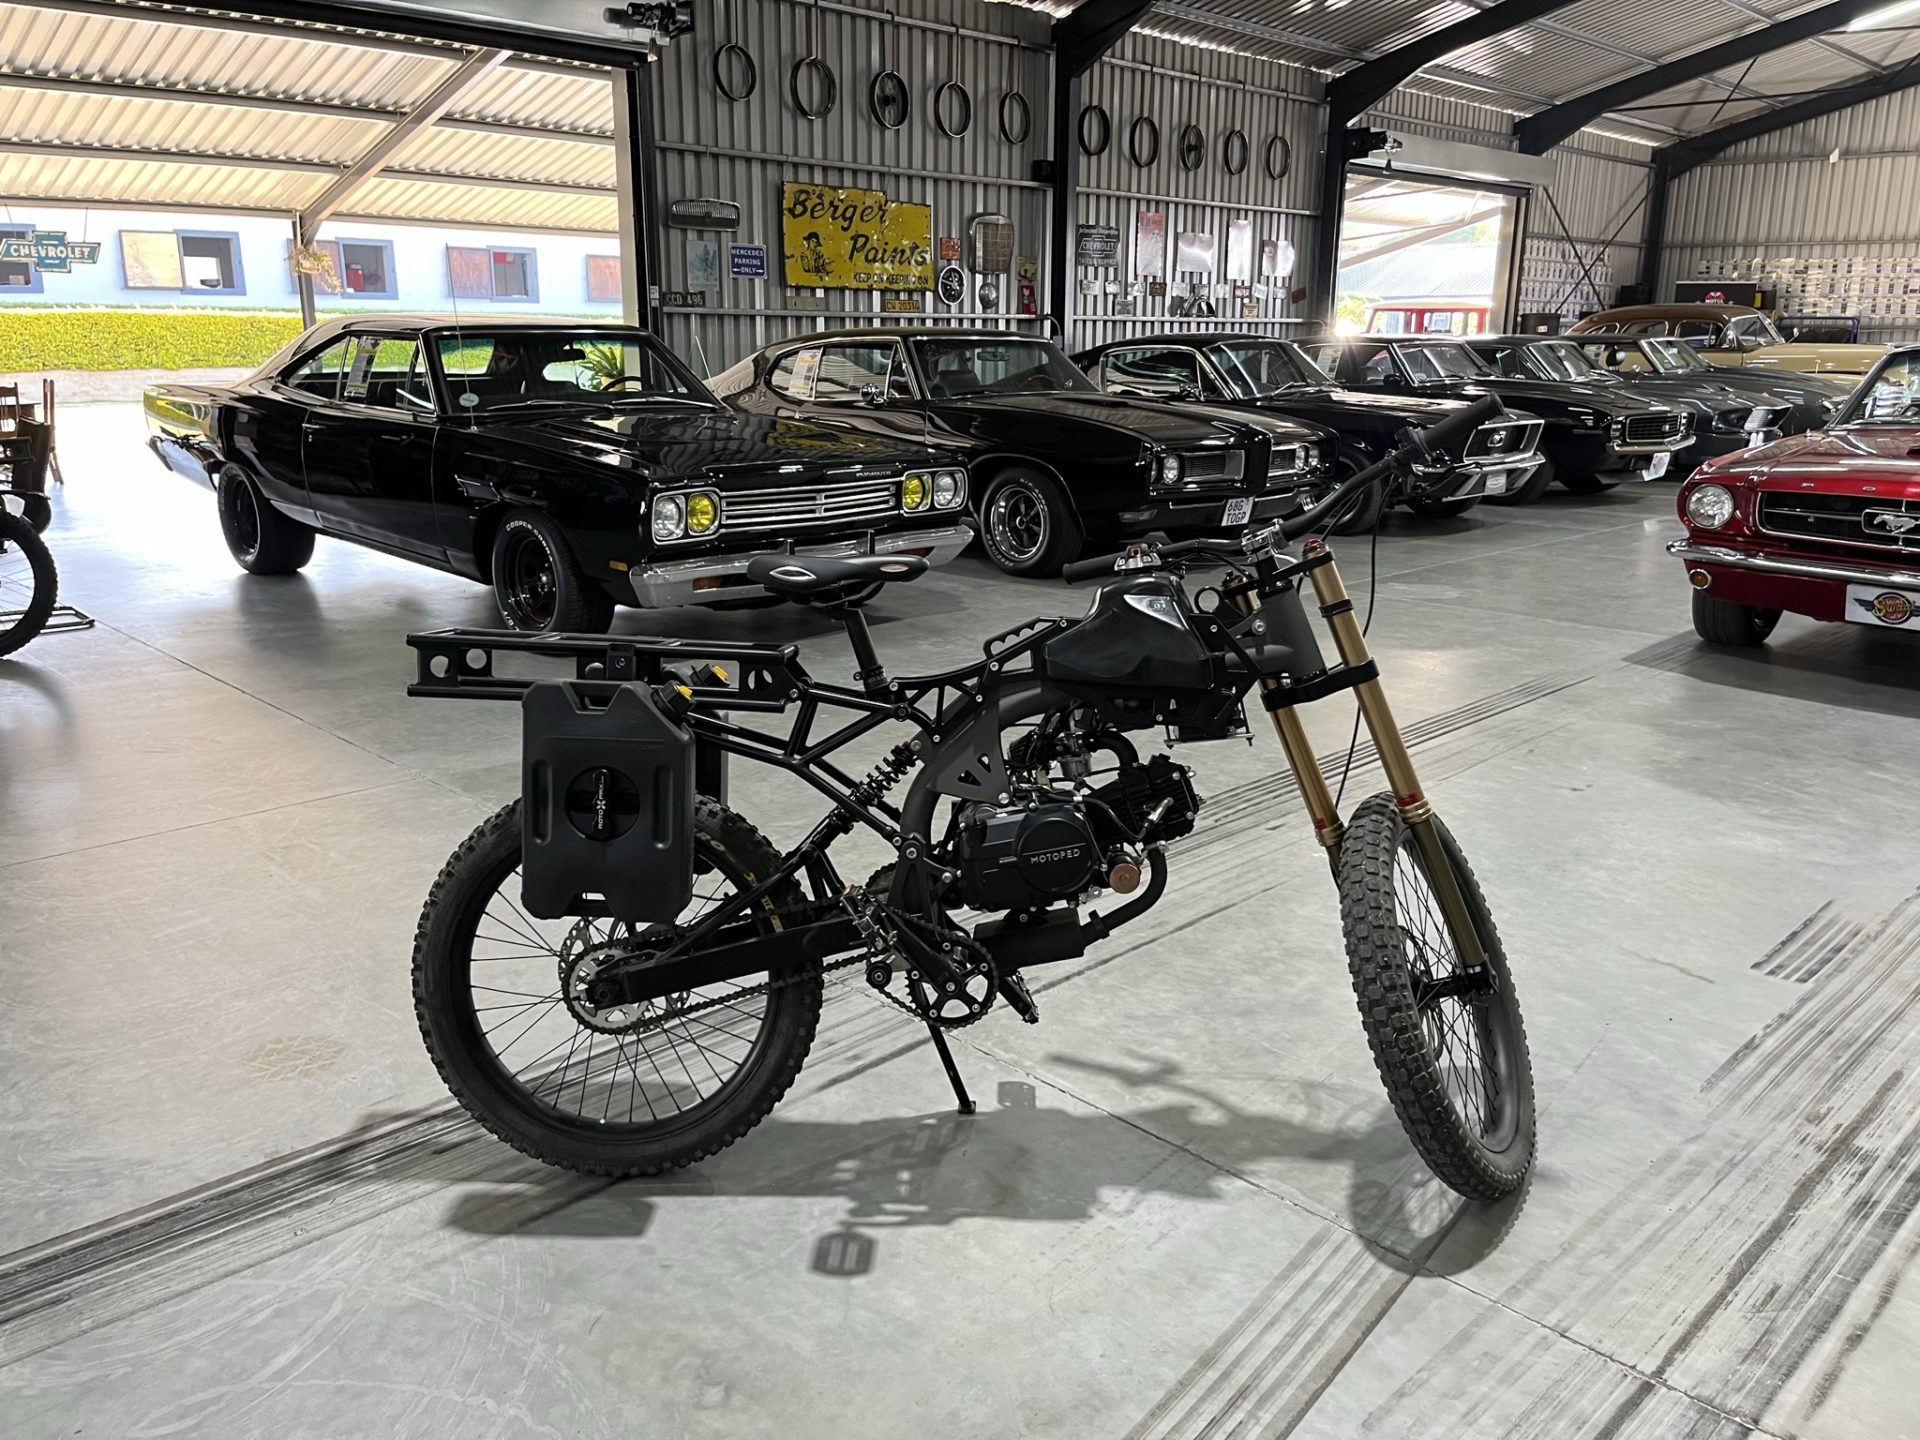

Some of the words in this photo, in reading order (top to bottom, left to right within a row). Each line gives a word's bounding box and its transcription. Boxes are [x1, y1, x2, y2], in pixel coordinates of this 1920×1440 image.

[786, 189, 888, 231] Berger
[10, 245, 91, 258] CHEVROLET
[848, 233, 928, 266] Paints
[1082, 241, 1114, 251] CHEVROLET
[731, 248, 763, 257] MERCEDES
[734, 257, 761, 265] PARKING
[740, 266, 757, 274] ONLY
[854, 272, 871, 283] KEEP
[872, 273, 885, 284] ON
[918, 275, 929, 286] ON
[1227, 500, 1244, 512] 68G
[1030, 848, 1080, 864] MOTOPED
